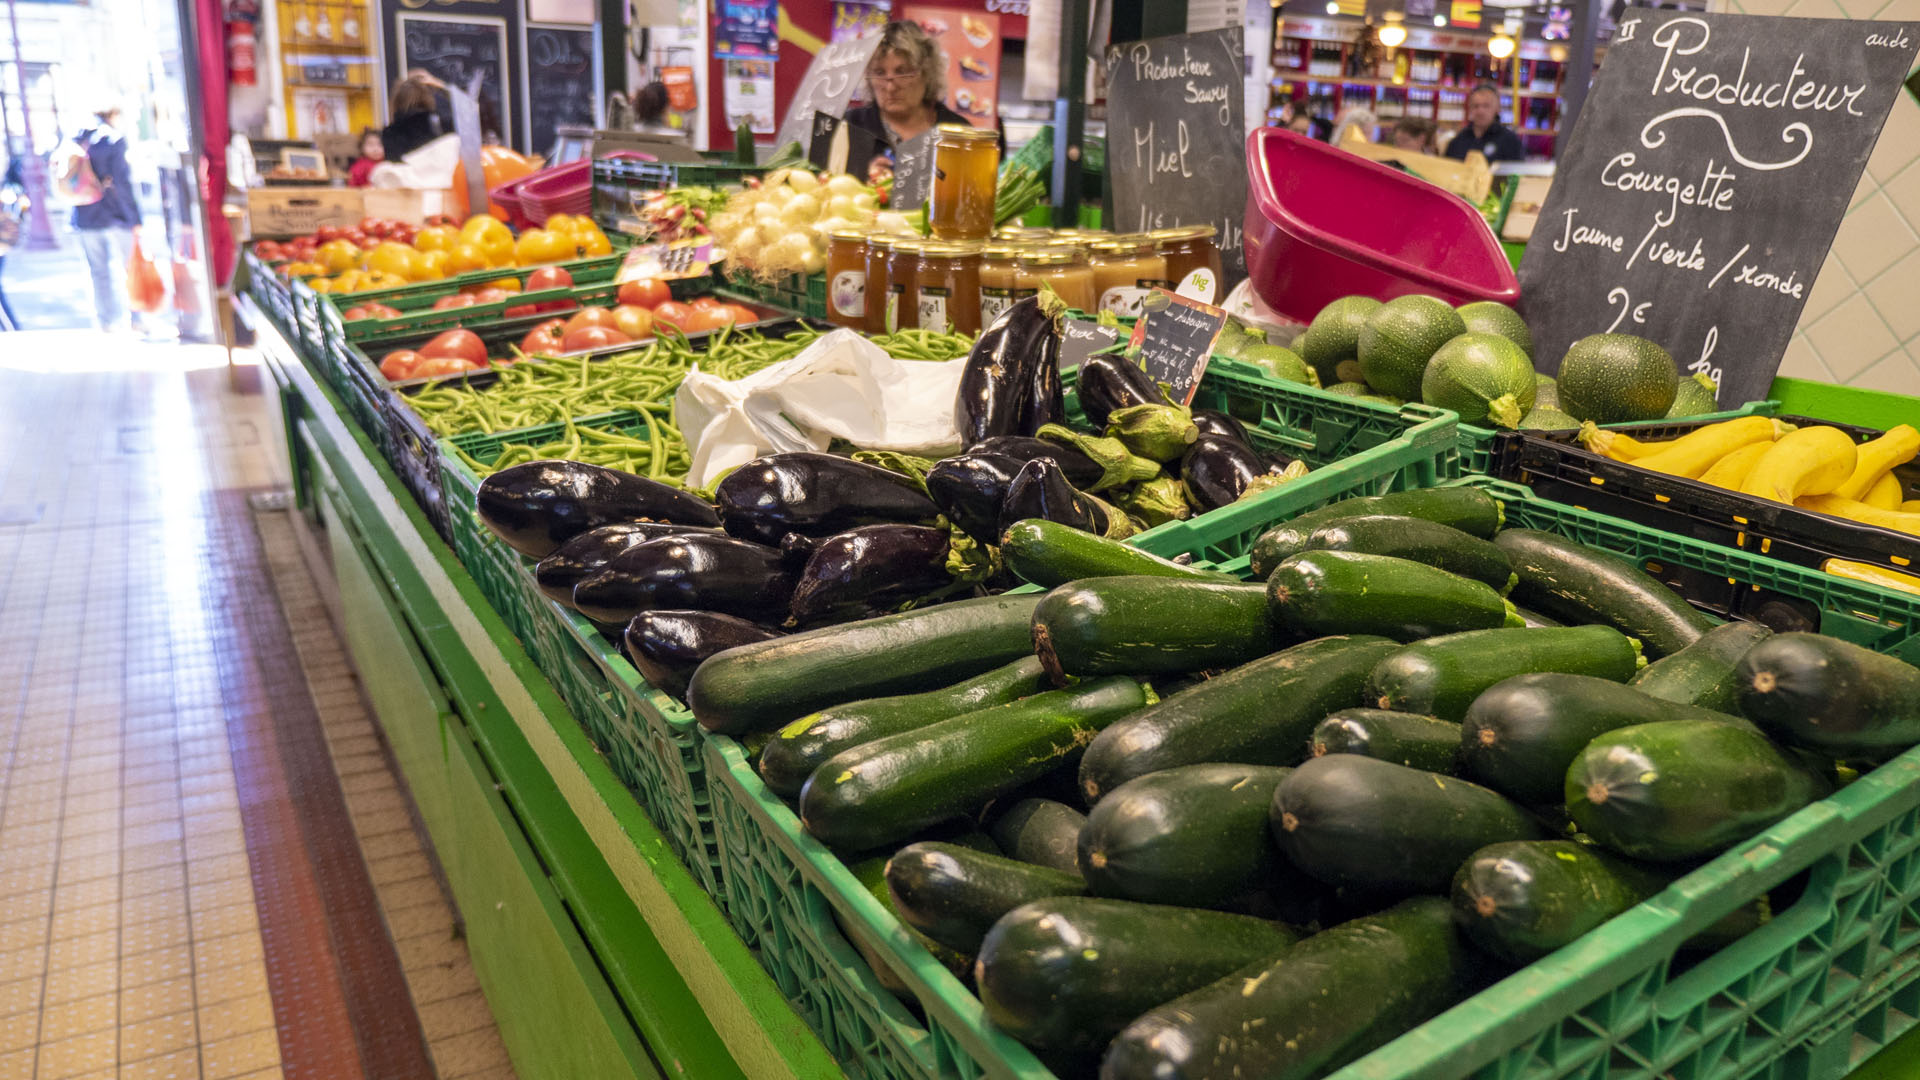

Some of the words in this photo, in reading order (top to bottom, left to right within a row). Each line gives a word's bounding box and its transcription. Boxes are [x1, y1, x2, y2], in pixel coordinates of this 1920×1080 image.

[1652, 17, 1866, 116] Producteur
[1134, 119, 1193, 184] Miel
[1600, 152, 1736, 228] Courgette
[1191, 273, 1209, 292] 1kg
